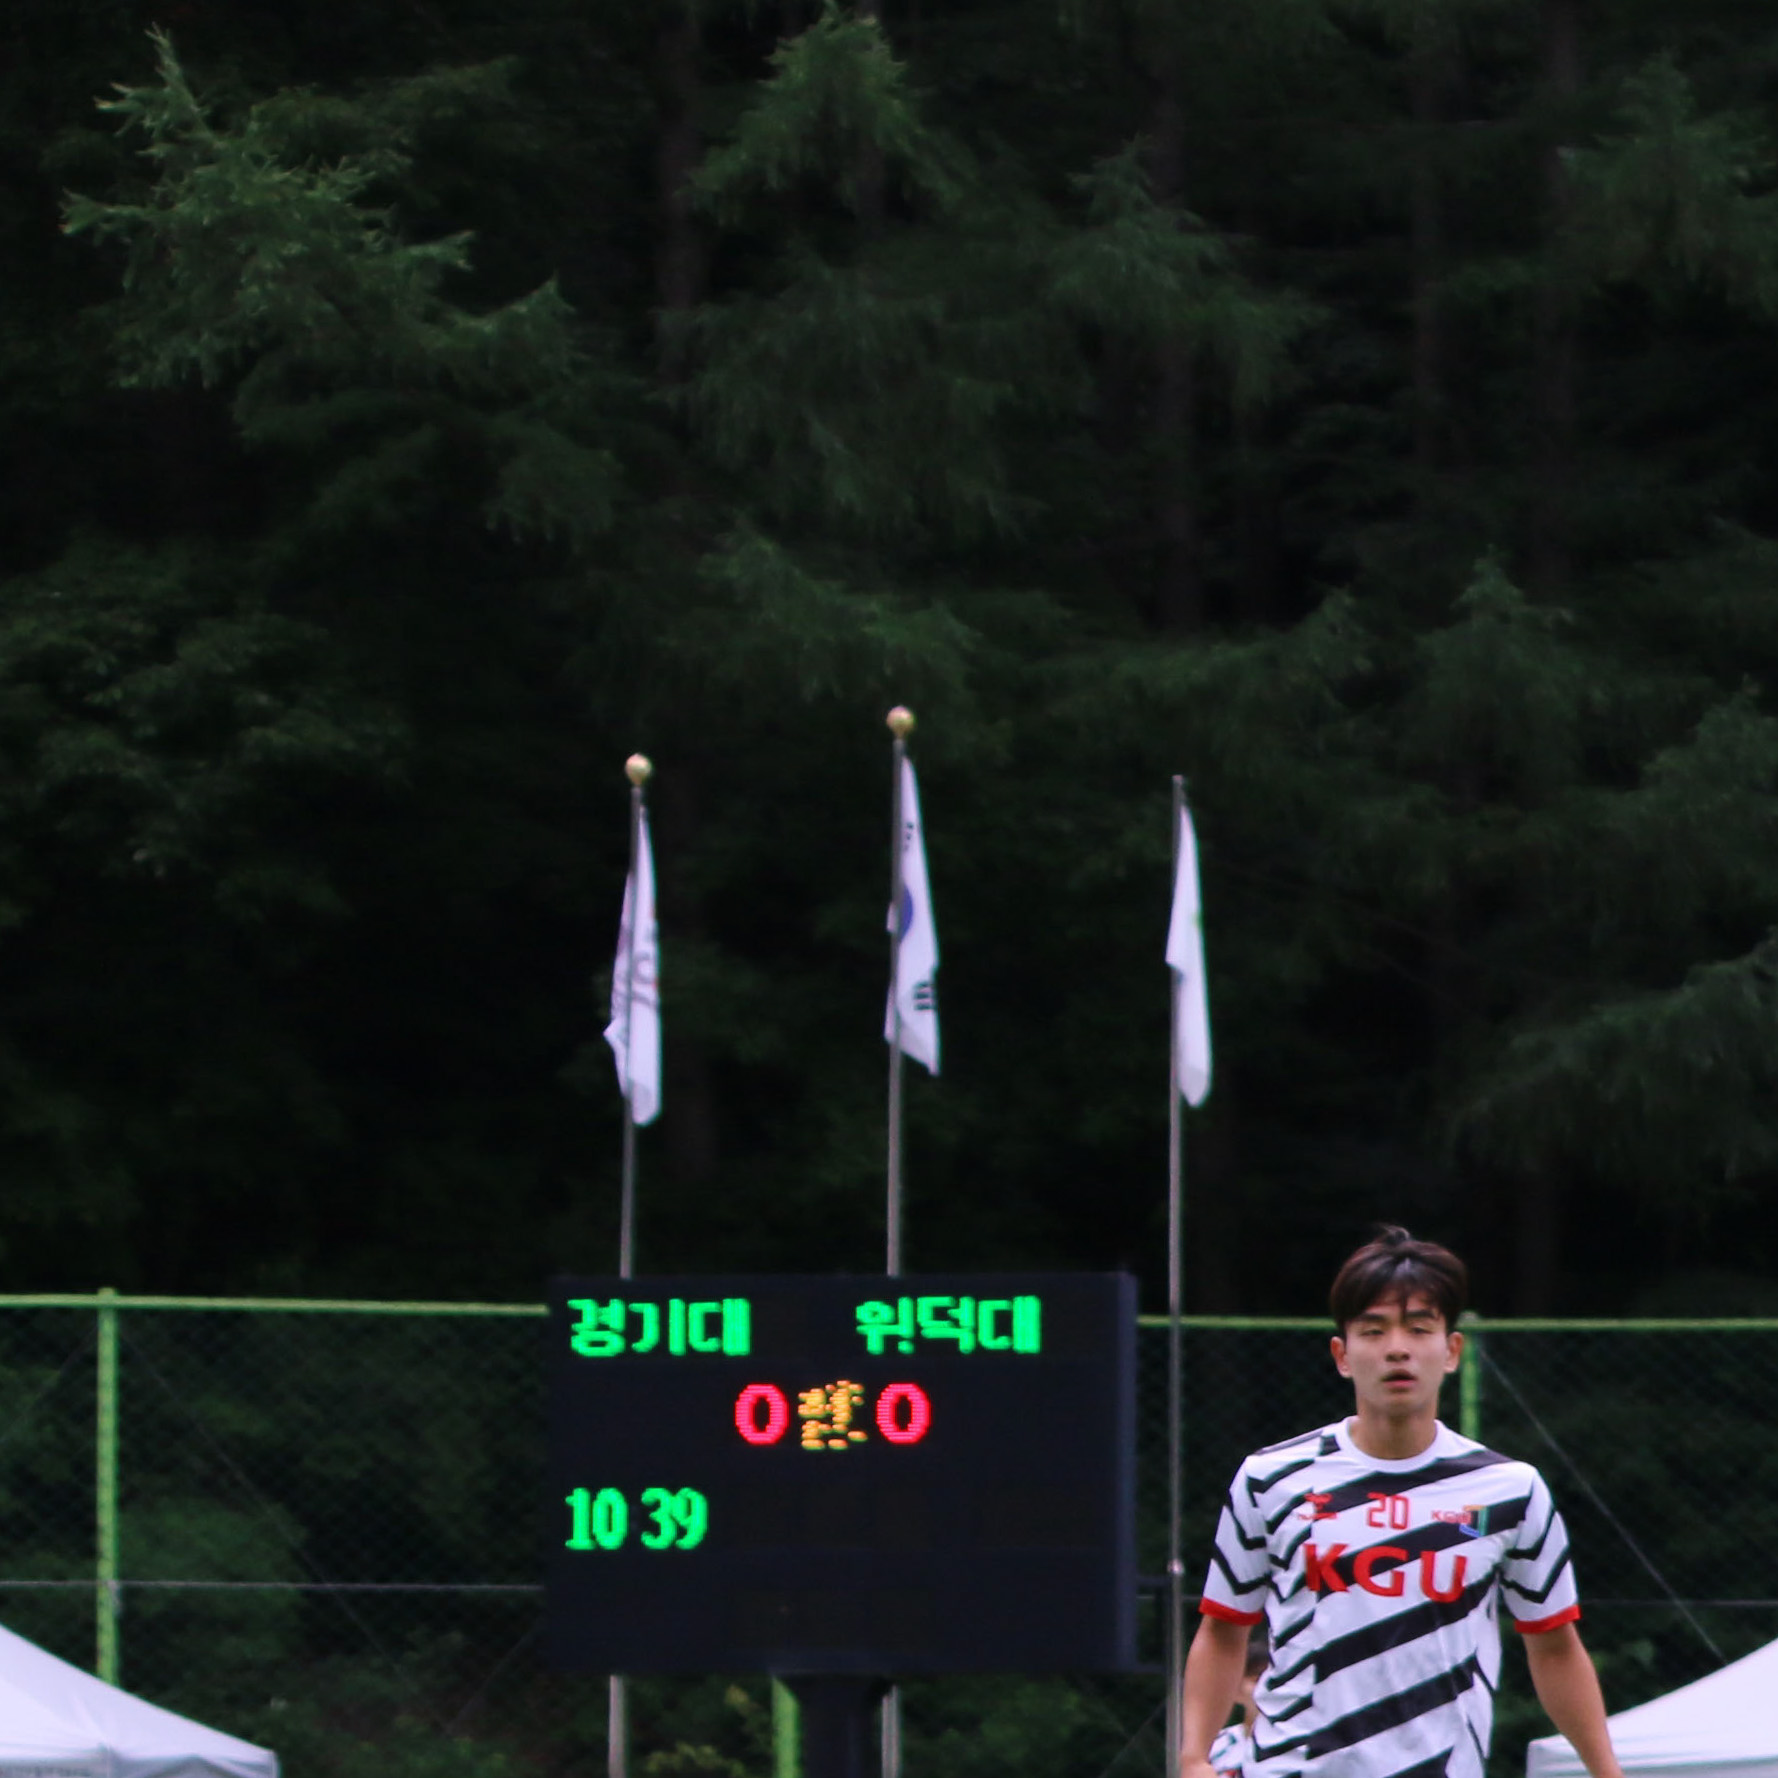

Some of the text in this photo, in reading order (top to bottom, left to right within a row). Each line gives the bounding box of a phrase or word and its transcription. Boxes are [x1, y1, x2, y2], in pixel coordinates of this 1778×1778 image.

[567, 1296, 1041, 1357] 경기대 위덕대
[735, 1384, 789, 1444] 0
[877, 1383, 931, 1443] 0
[565, 1488, 707, 1550] 10 39
[1366, 1492, 1410, 1530] 20
[1303, 1543, 1468, 1603] KGU
